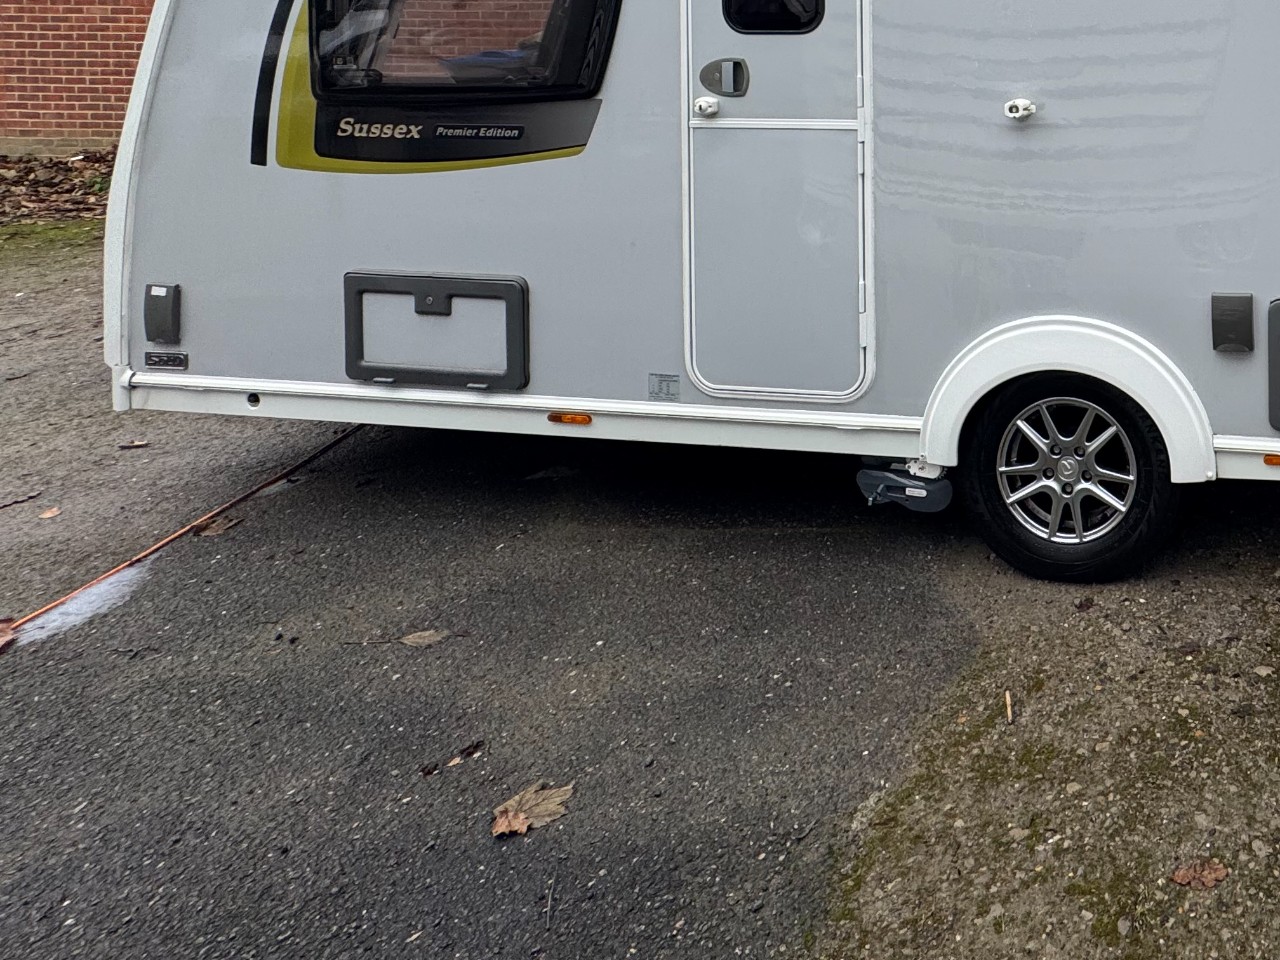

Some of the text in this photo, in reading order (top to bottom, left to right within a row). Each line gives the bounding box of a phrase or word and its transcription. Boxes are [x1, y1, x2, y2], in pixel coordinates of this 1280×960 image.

[336, 117, 520, 139] Sussex Premier Edition
